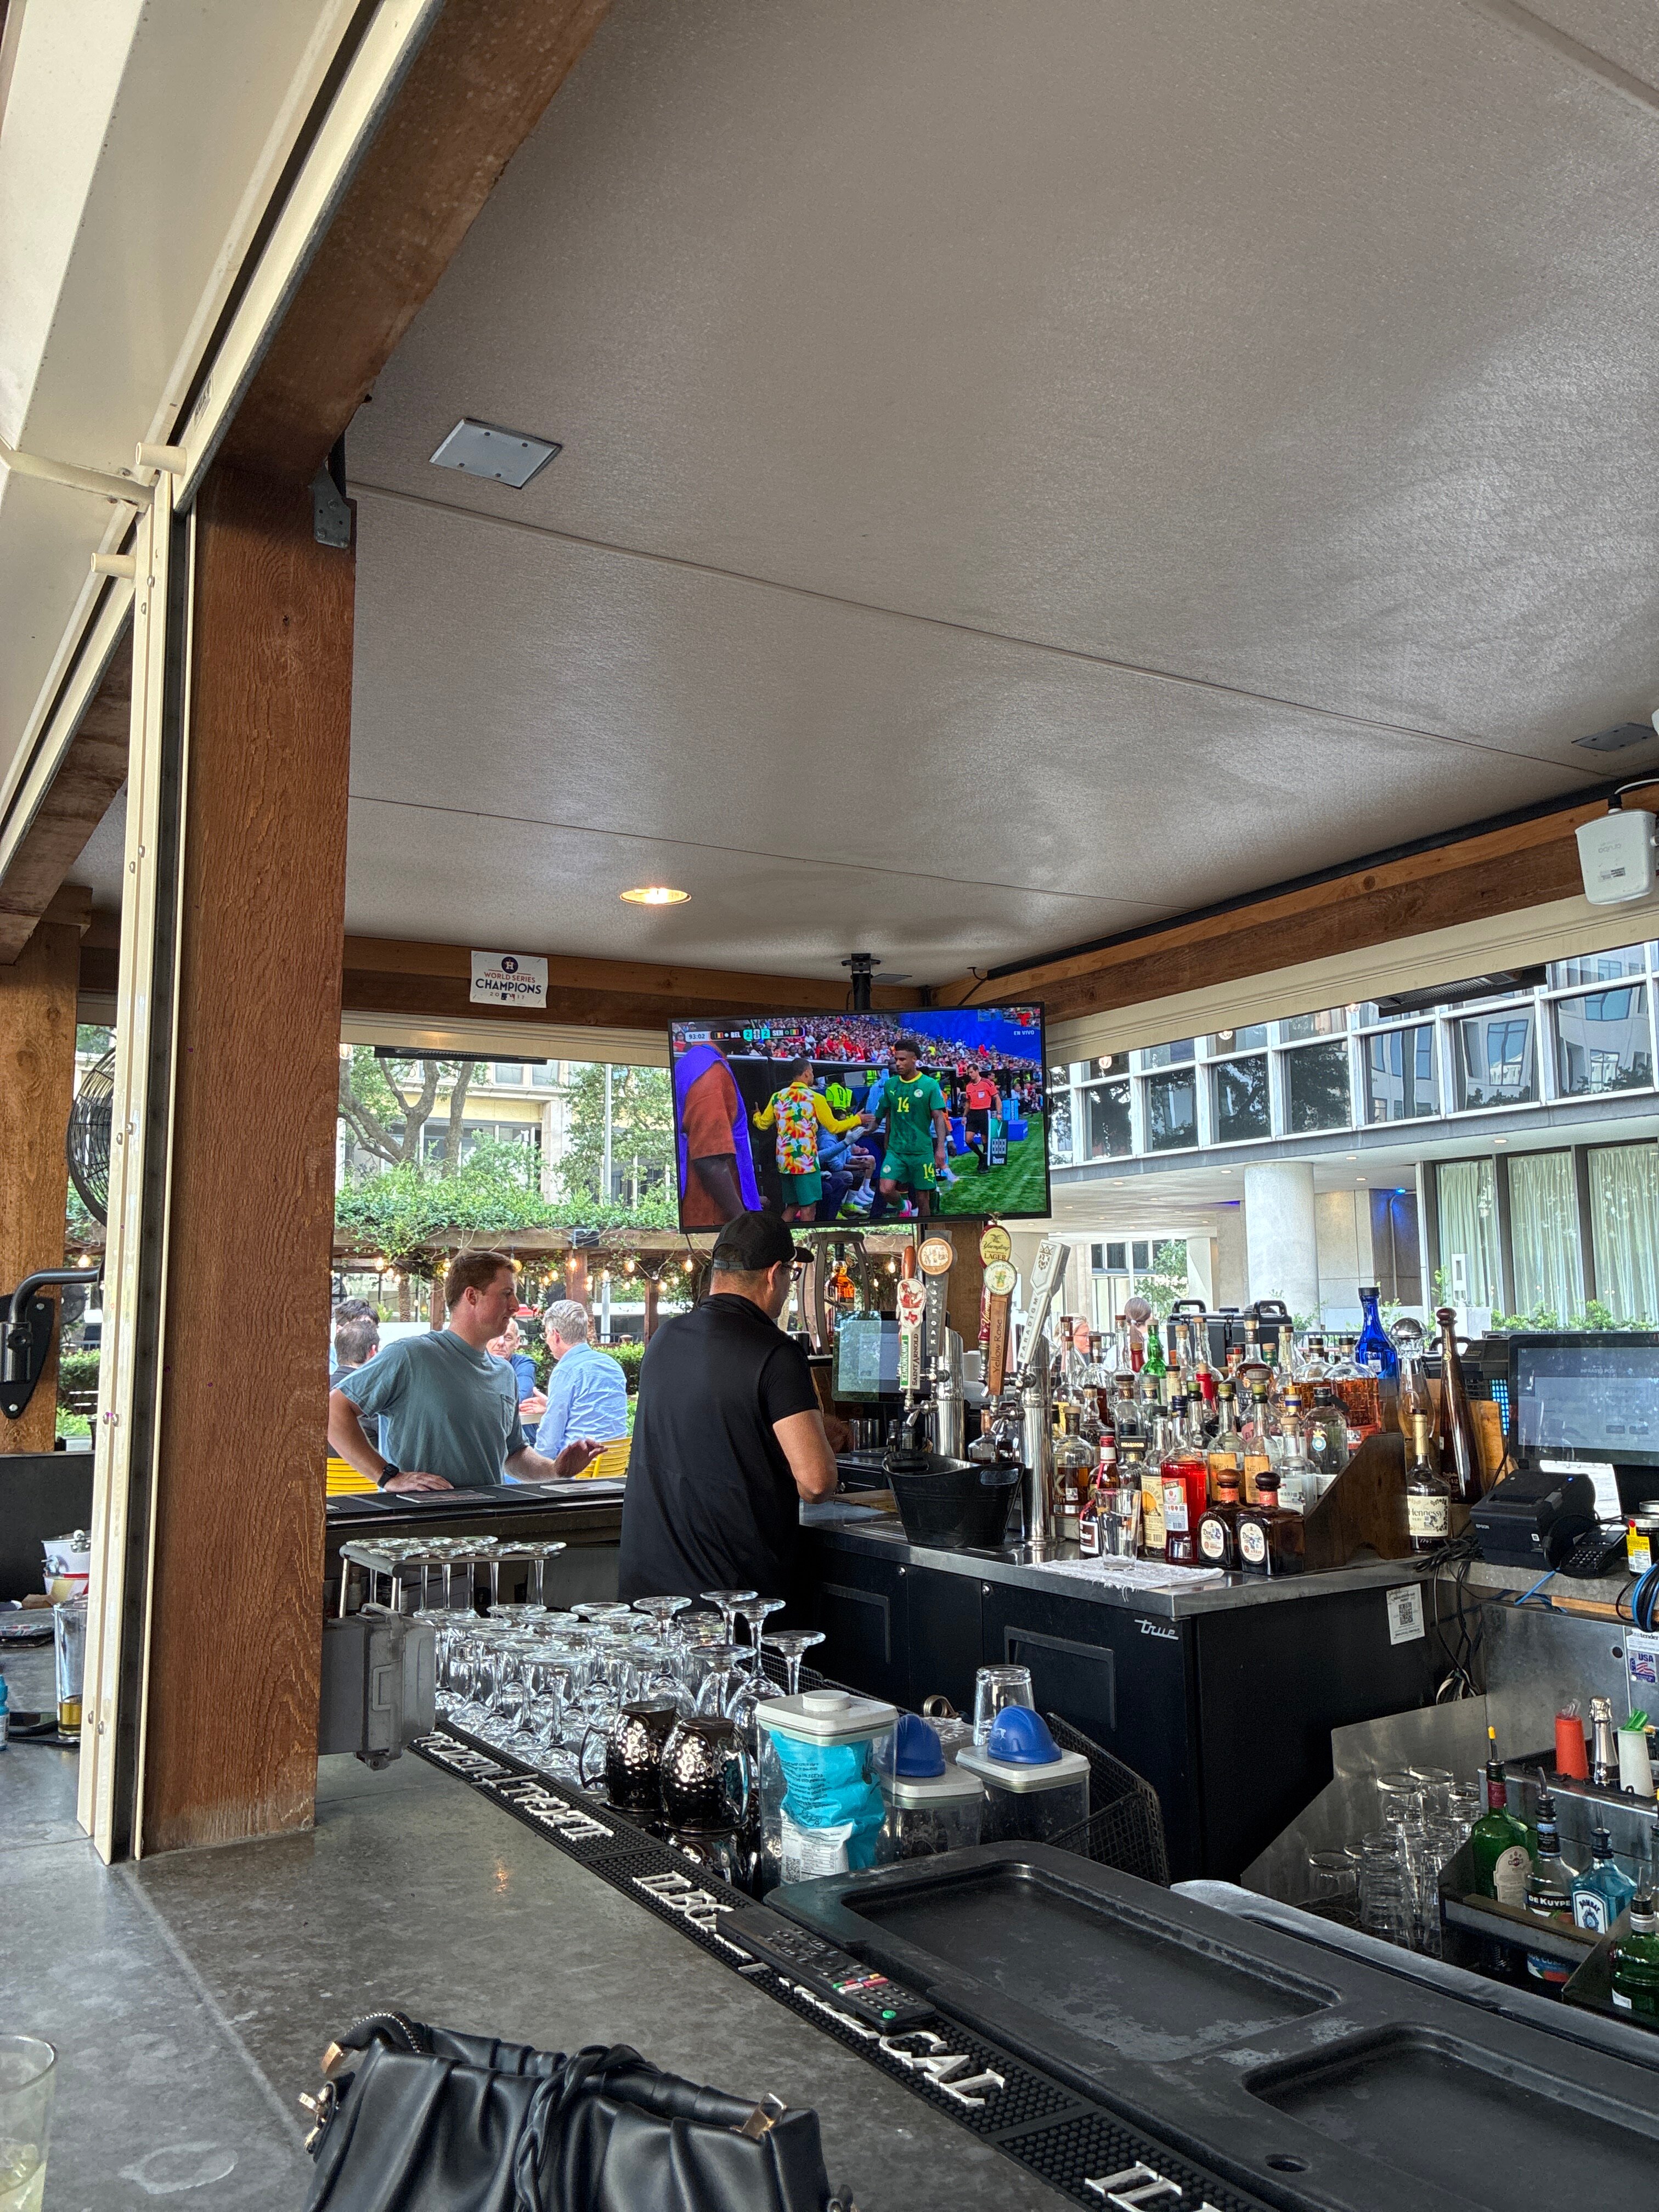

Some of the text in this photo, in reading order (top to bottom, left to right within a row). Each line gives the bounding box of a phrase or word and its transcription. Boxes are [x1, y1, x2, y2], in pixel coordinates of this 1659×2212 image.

[484, 972, 535, 983] WORLD SERIES
[475, 978, 541, 994] CHAMPIONS
[896, 1097, 910, 1113] 14
[923, 1162, 935, 1179] 14
[984, 1252, 1006, 1261] LAGER
[1019, 1297, 1039, 1358] PARADIGM
[992, 1318, 1002, 1373] Yellow Rose
[1638, 1652, 1654, 1663] USA
[1579, 1899, 1601, 1913] BOMBAY
